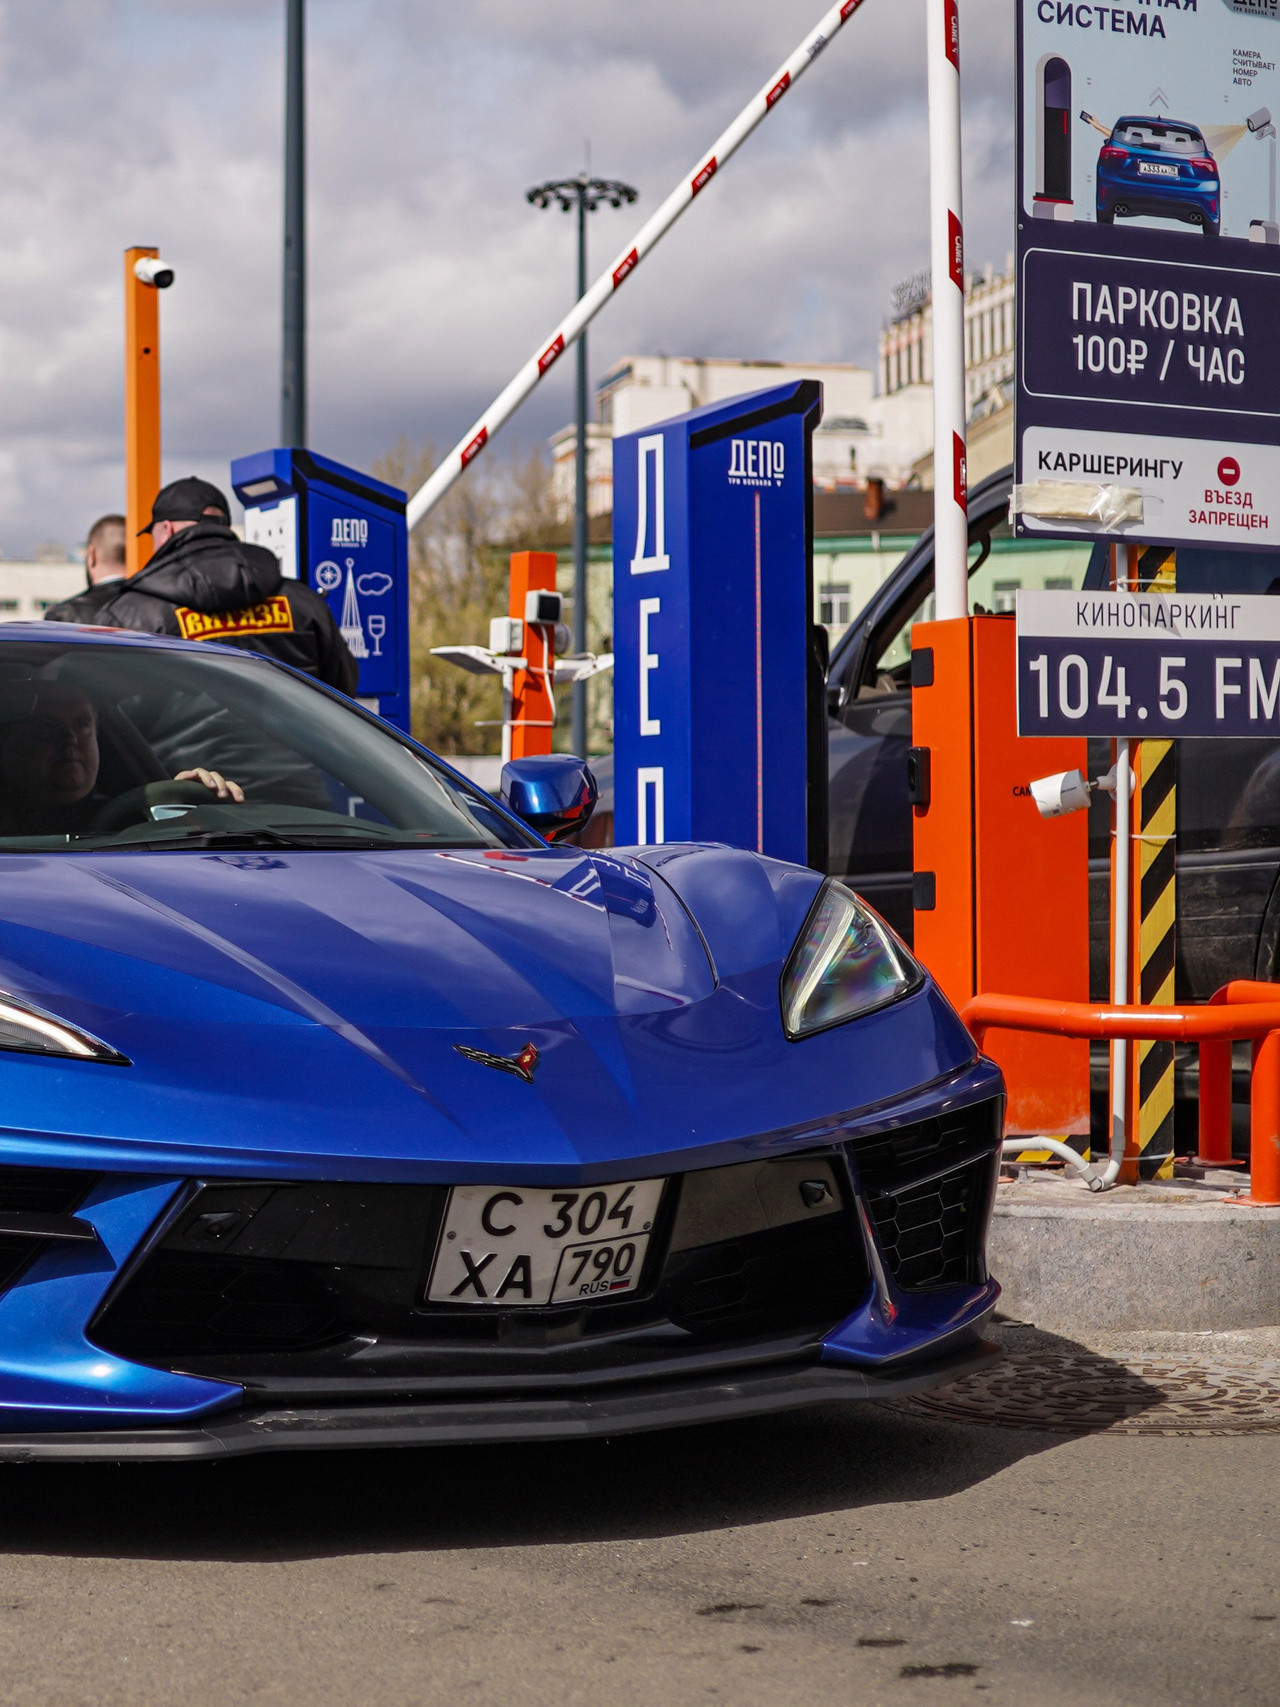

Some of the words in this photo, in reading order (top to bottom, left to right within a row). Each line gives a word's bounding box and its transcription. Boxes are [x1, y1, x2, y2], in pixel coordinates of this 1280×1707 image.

[1037, 0, 1167, 39] СИСТЕМА
[1232, 48, 1262, 60] КАМЕРА
[1232, 58, 1276, 71] СЧИТЫВАЕТ
[1232, 67, 1258, 77] НОМЕР
[1232, 77, 1252, 87] АВТО
[1072, 281, 1245, 337] ПАРКОВКА
[1072, 334, 1148, 376] 100₽
[1187, 345, 1245, 385] ЧАС
[727, 438, 785, 479] ДЕПО
[1038, 450, 1183, 480] КАРШЕРИНГУ
[1204, 489, 1253, 509] ВЪЕЗД
[331, 518, 368, 543] ДЕПО
[1188, 509, 1269, 530] ЗАПРЕЩЕН
[1076, 602, 1241, 629] КИНОПАРКИНГ
[630, 433, 670, 846] ДЕП
[1029, 654, 1188, 720] 104.5
[1215, 657, 1280, 720] FM
[481, 1191, 524, 1237] С
[543, 1185, 636, 1239] 304
[449, 1251, 532, 1299] ХА
[568, 1242, 637, 1287] 790
[578, 1280, 610, 1296] RUS
